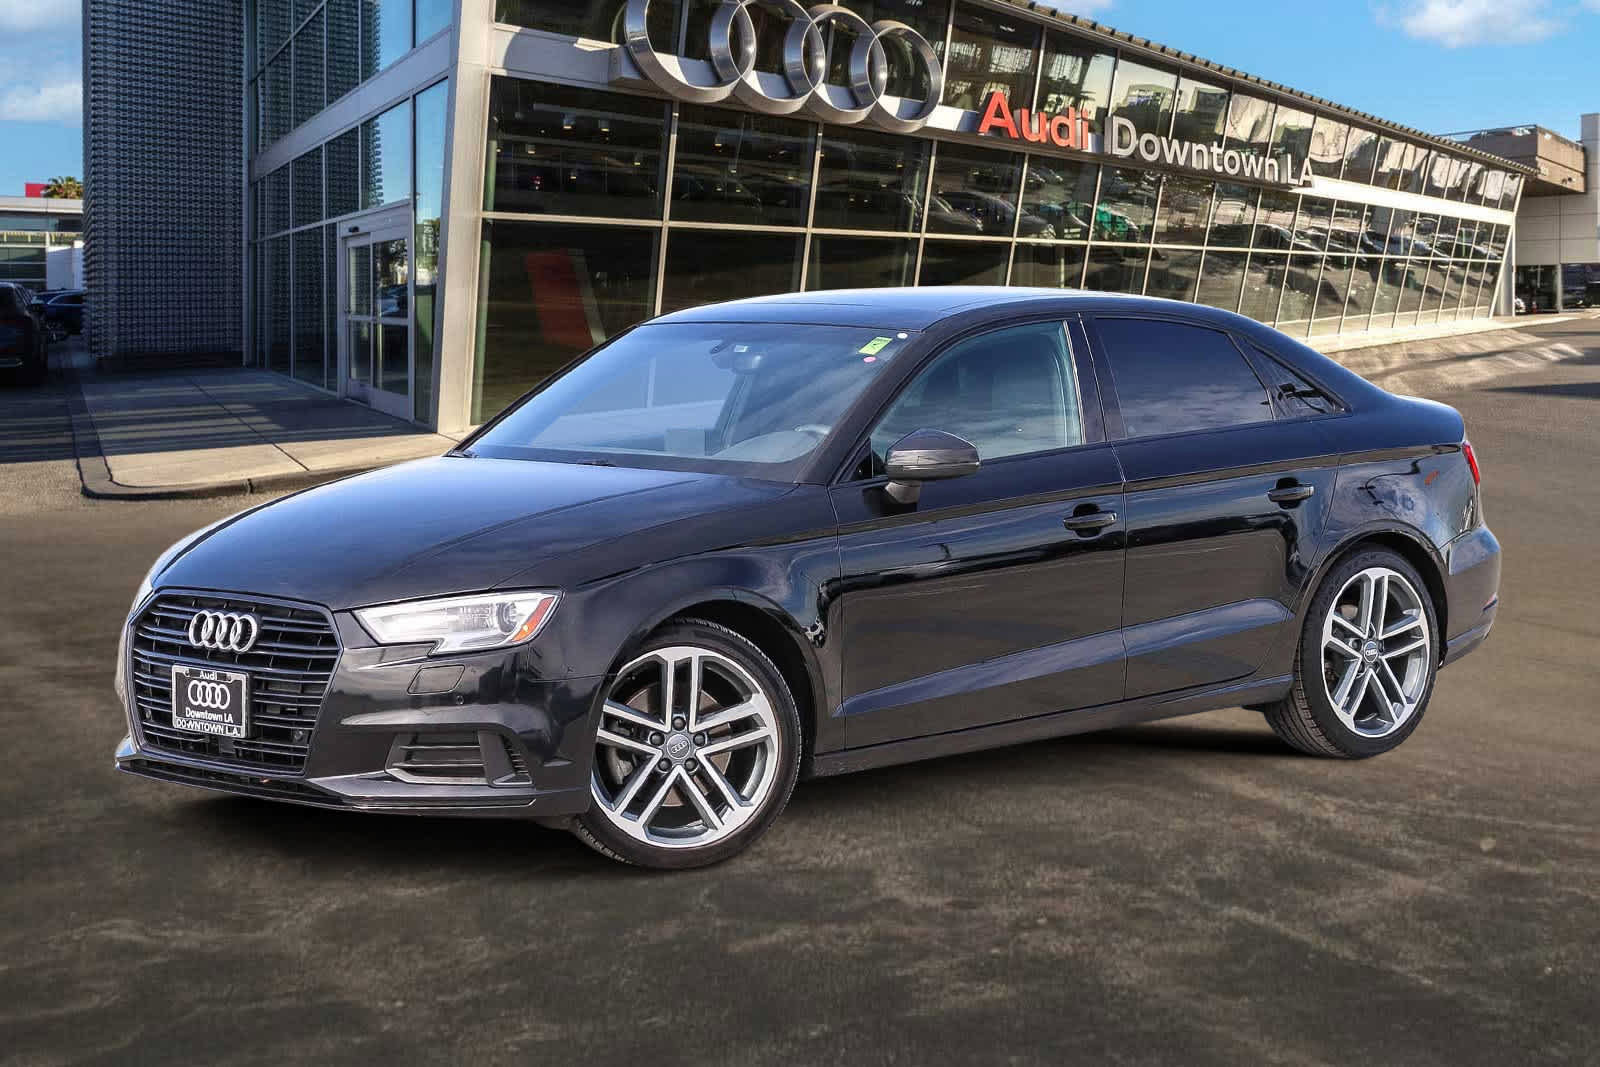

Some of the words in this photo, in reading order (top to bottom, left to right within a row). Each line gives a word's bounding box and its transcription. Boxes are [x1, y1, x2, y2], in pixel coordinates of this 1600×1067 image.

[978, 91, 1089, 151] Audi
[1106, 115, 1280, 184] Downtown
[1287, 153, 1316, 188] LA
[200, 670, 217, 680] Audi
[185, 707, 223, 721] Downtown
[224, 713, 233, 723] LA
[176, 719, 224, 734] DOWNTOWN
